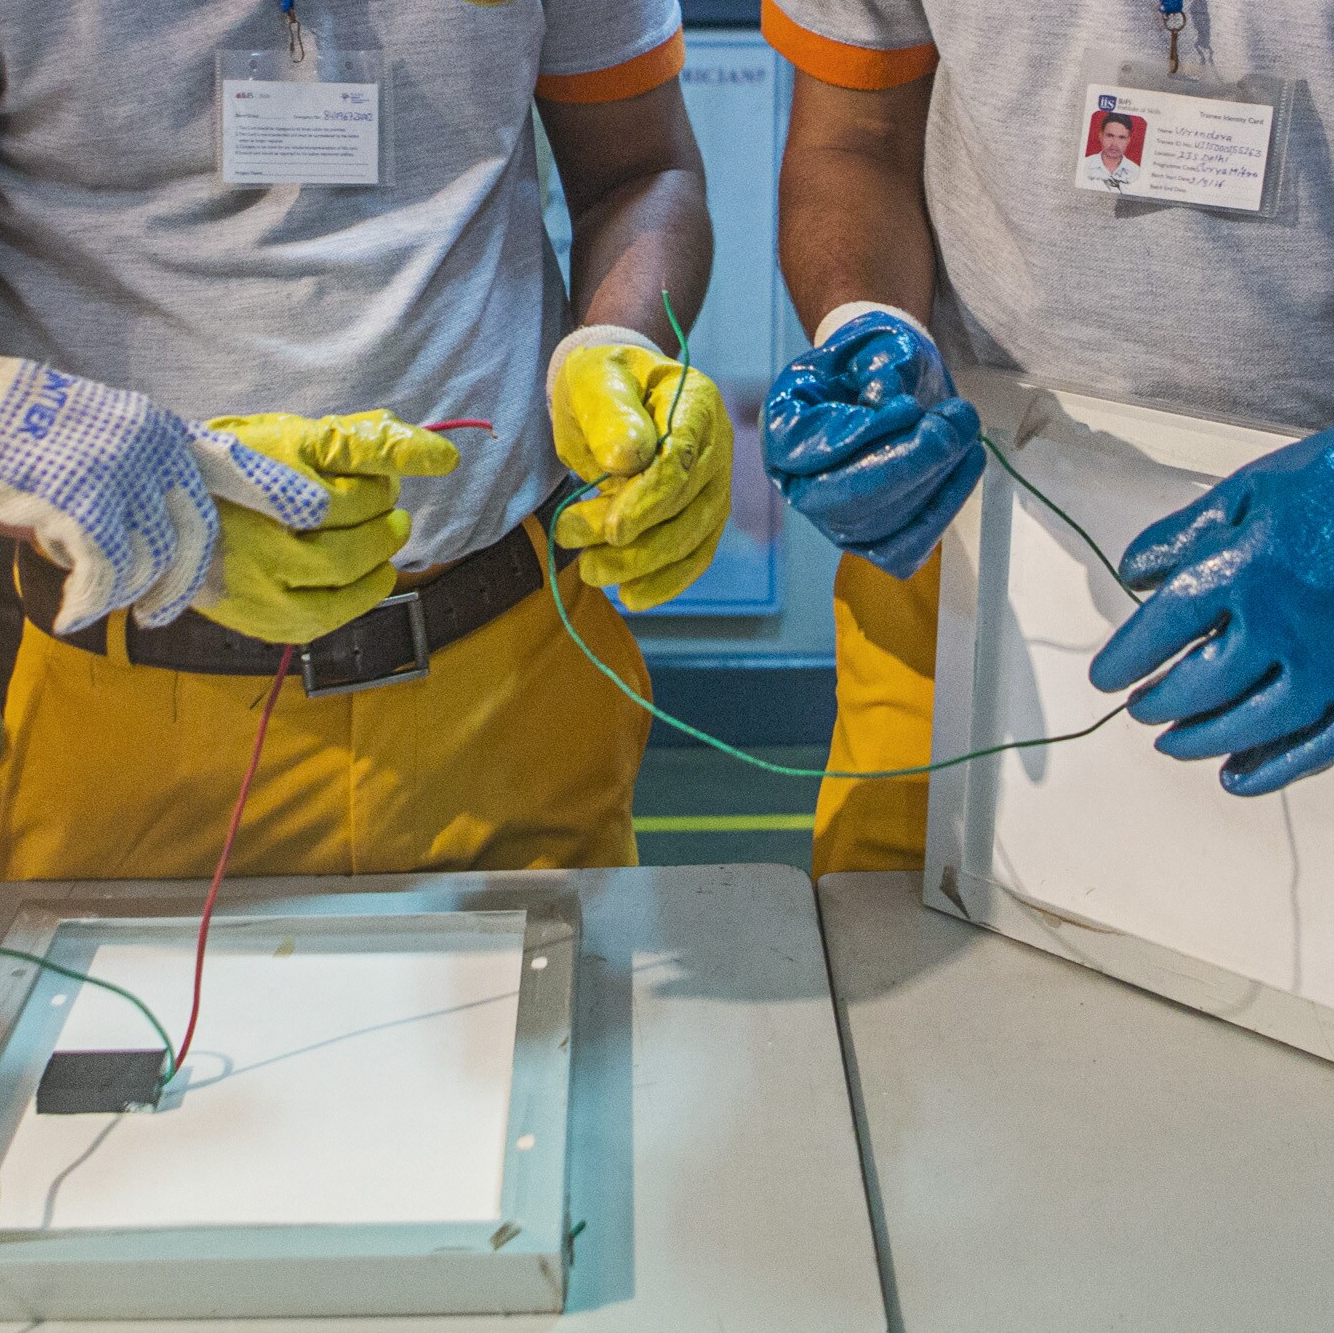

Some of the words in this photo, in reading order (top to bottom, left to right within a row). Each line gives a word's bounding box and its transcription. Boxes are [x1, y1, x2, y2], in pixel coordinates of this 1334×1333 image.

[1199, 111, 1222, 121] Trainee
[1223, 114, 1247, 124] Identity
[1248, 116, 1264, 125] Card
